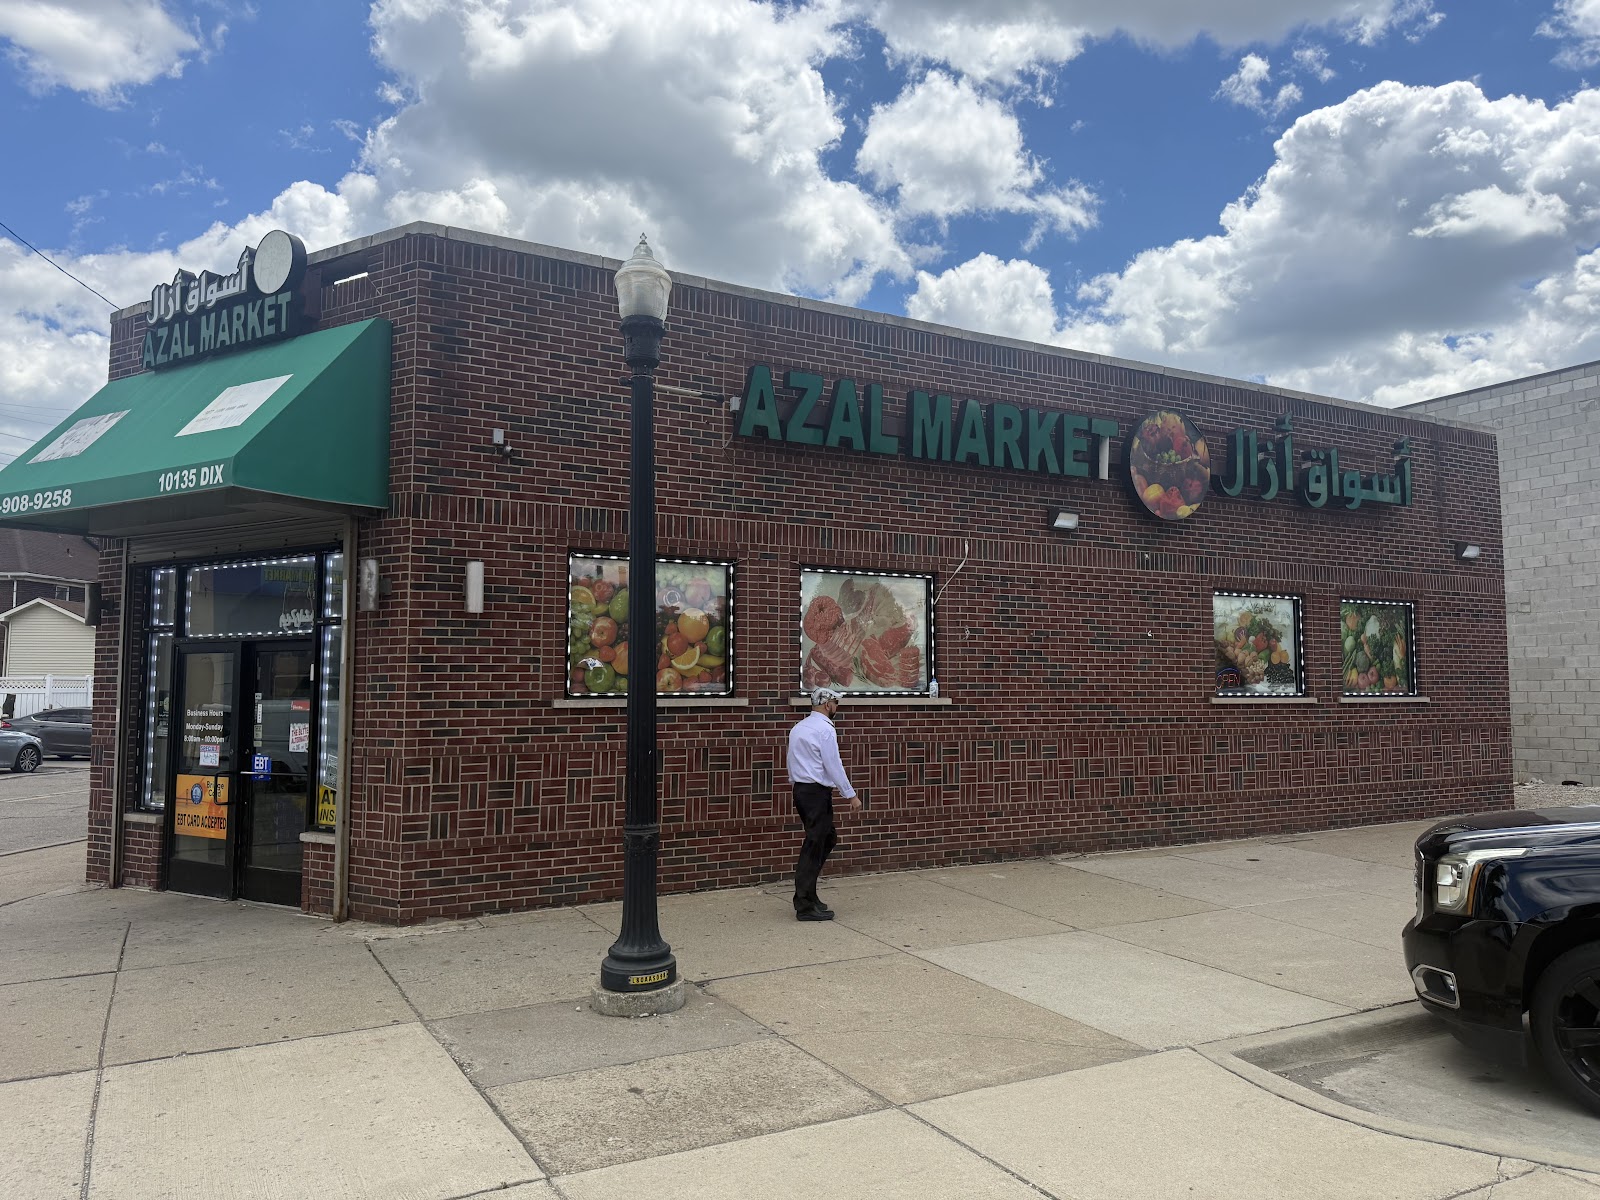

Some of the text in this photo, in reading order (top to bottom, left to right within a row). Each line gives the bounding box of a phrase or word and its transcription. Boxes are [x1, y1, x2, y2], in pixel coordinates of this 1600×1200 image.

[146, 252, 249, 324] أسواق أزال
[142, 290, 292, 369] AZAL MARKET
[736, 364, 1120, 481] AZAL MARKET
[1218, 410, 1412, 510] أسواق أزال
[158, 463, 225, 493] 10135 DIX
[186, 709, 224, 717] Business Hours
[185, 722, 224, 732] Monday-Sunday
[183, 735, 201, 743] 8:00am
[254, 756, 269, 770] EBT
[321, 789, 337, 805] AT
[177, 813, 226, 830] EBT CARD ACCEPTED
